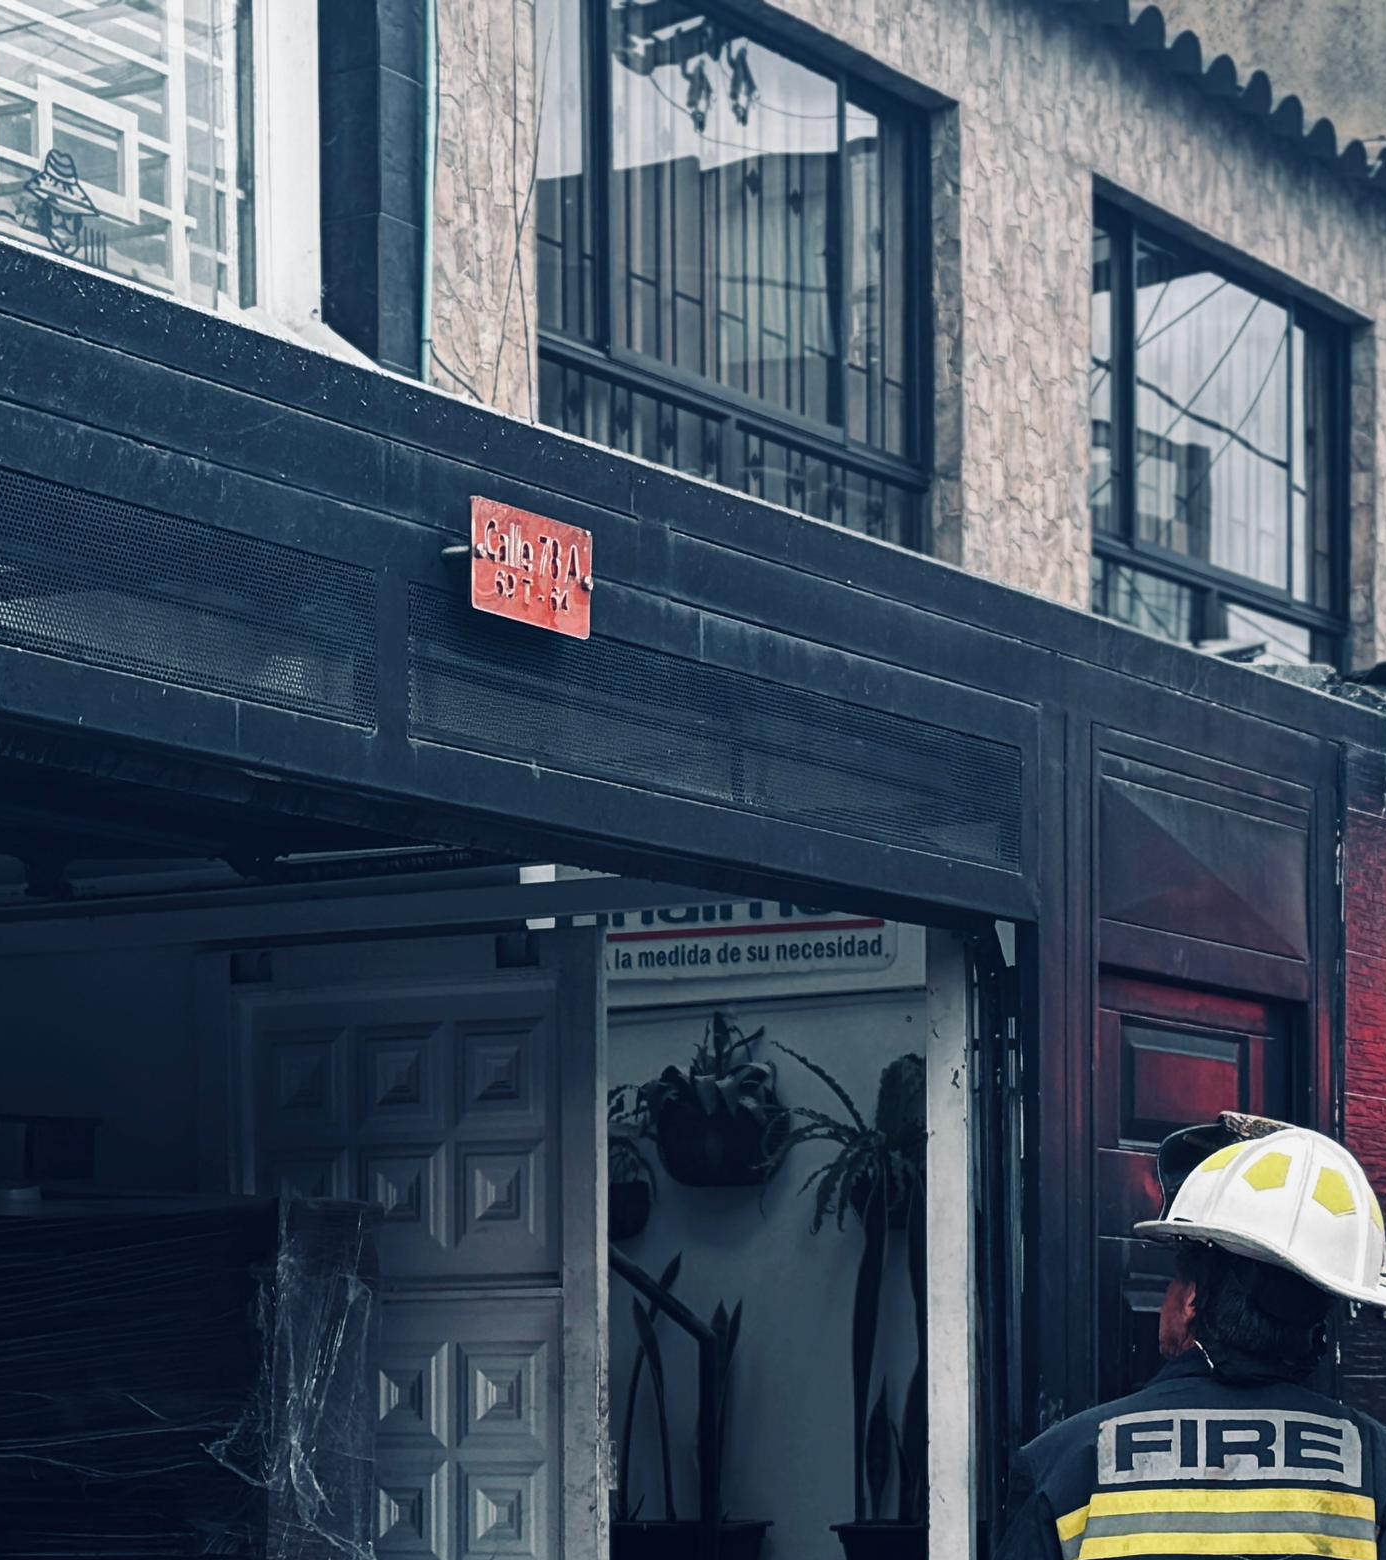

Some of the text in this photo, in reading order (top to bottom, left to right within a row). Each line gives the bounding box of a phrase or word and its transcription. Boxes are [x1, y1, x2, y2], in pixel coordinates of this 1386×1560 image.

[485, 518, 534, 573] Calle
[614, 934, 883, 970] la medida de su necesidad
[1114, 1418, 1344, 1474] FIRE
